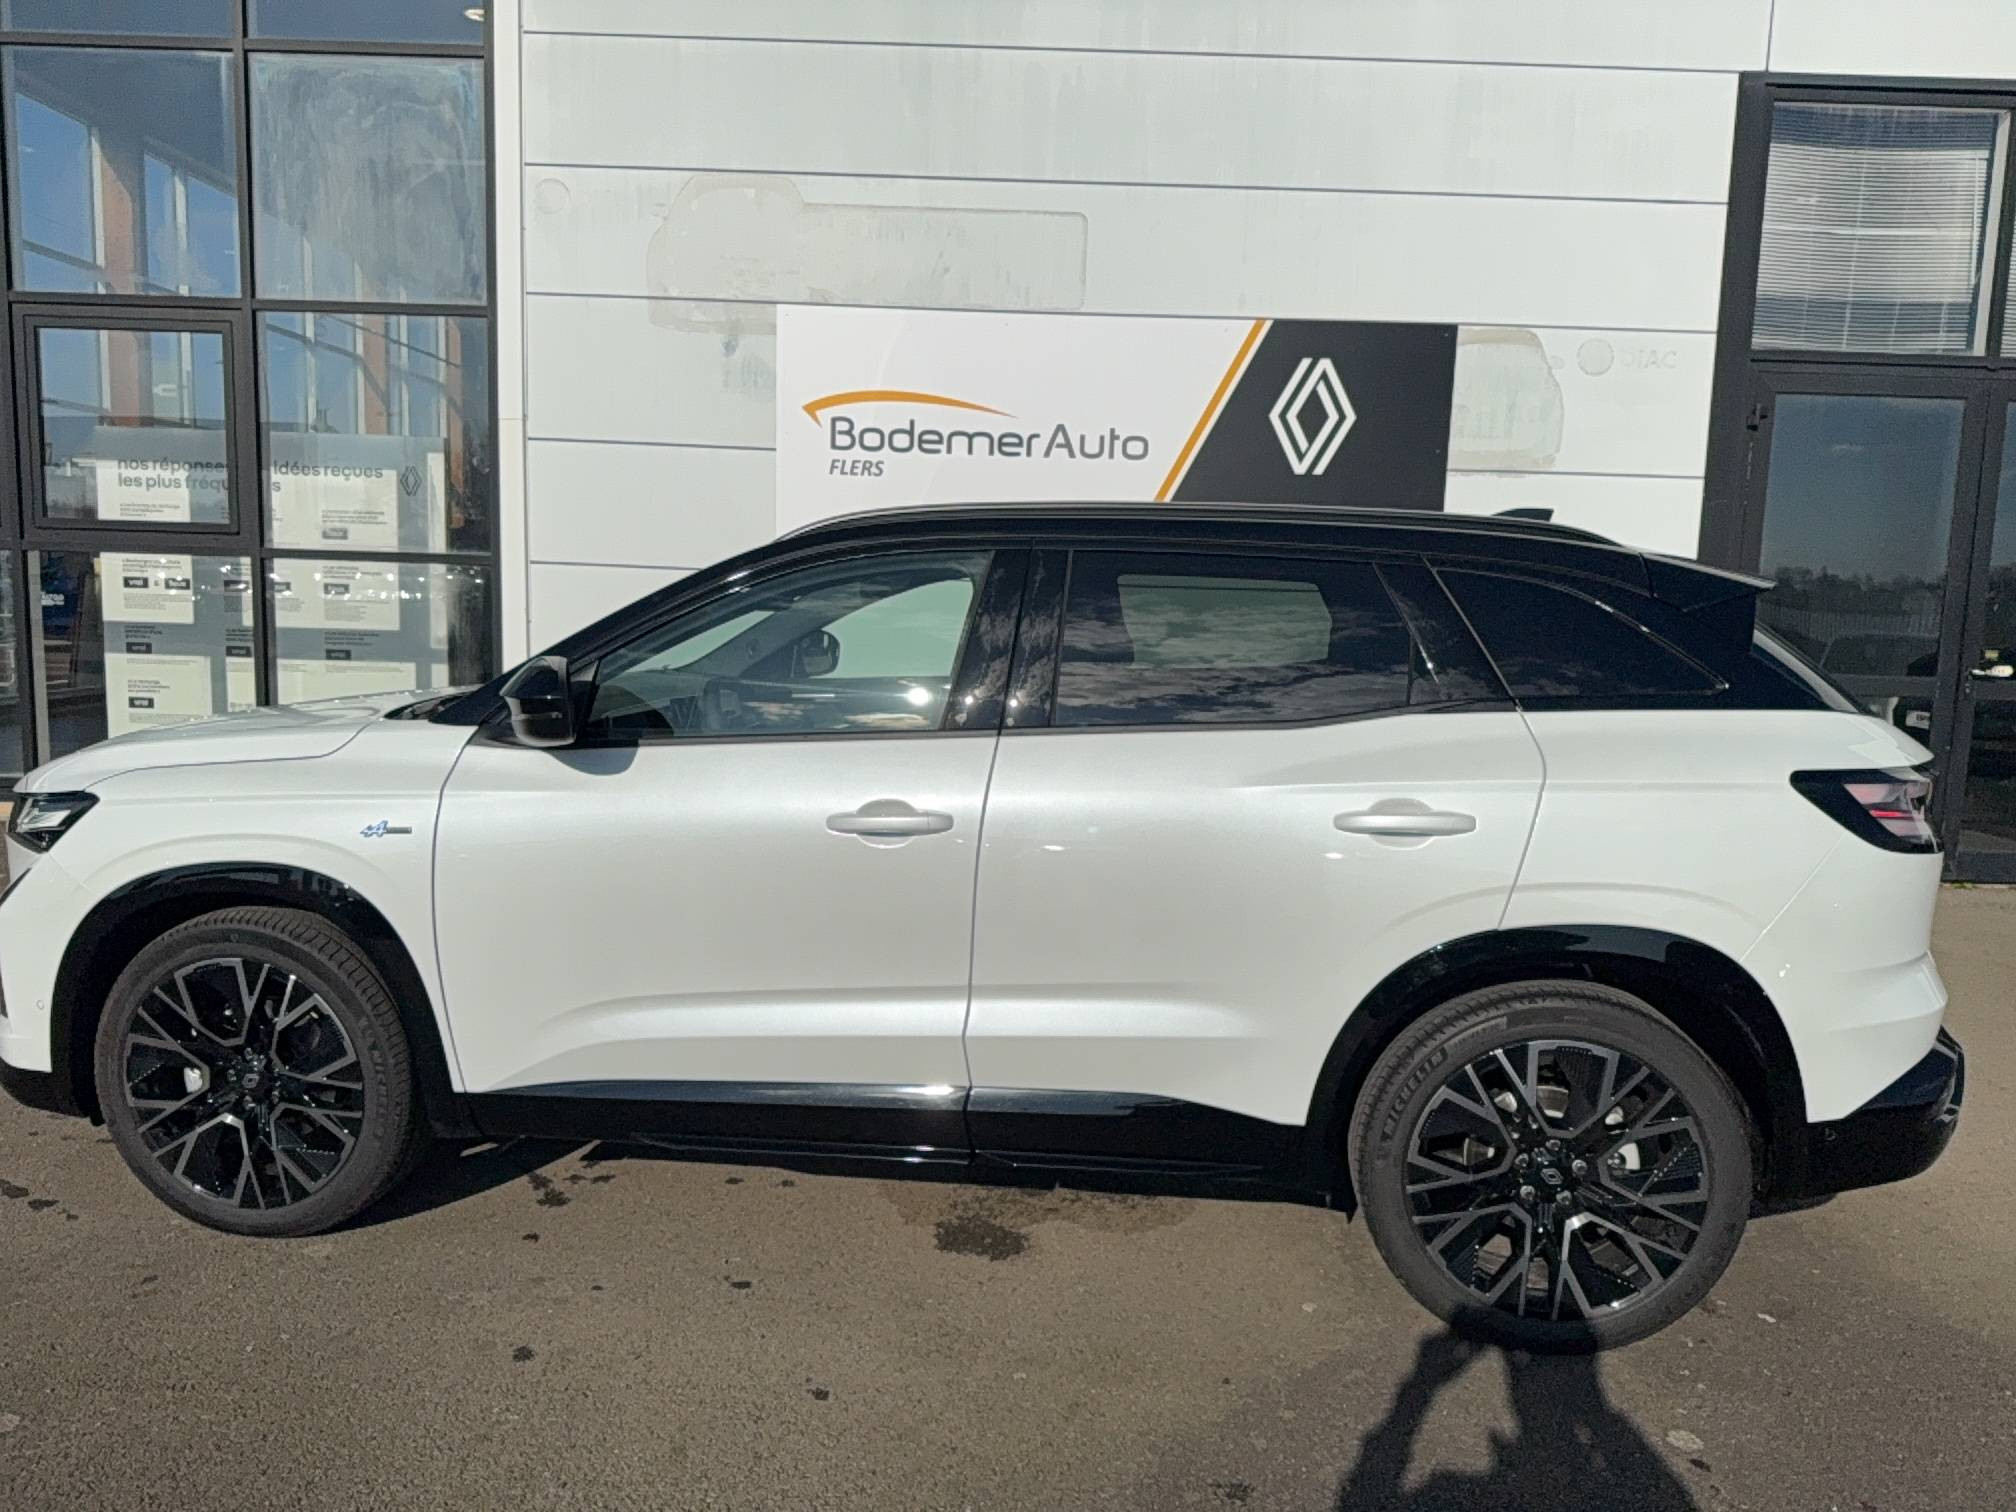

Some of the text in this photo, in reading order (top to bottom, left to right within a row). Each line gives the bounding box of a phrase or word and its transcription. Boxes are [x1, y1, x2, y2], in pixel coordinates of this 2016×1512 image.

[830, 416, 1149, 460] BodemerAuto
[117, 458, 148, 471] nos
[153, 457, 230, 476] réponse
[323, 465, 383, 482] reçues
[829, 459, 884, 477] FLERS
[118, 472, 142, 487] les
[146, 474, 182, 492] plus
[1383, 1050, 1445, 1136] MICHELIN
